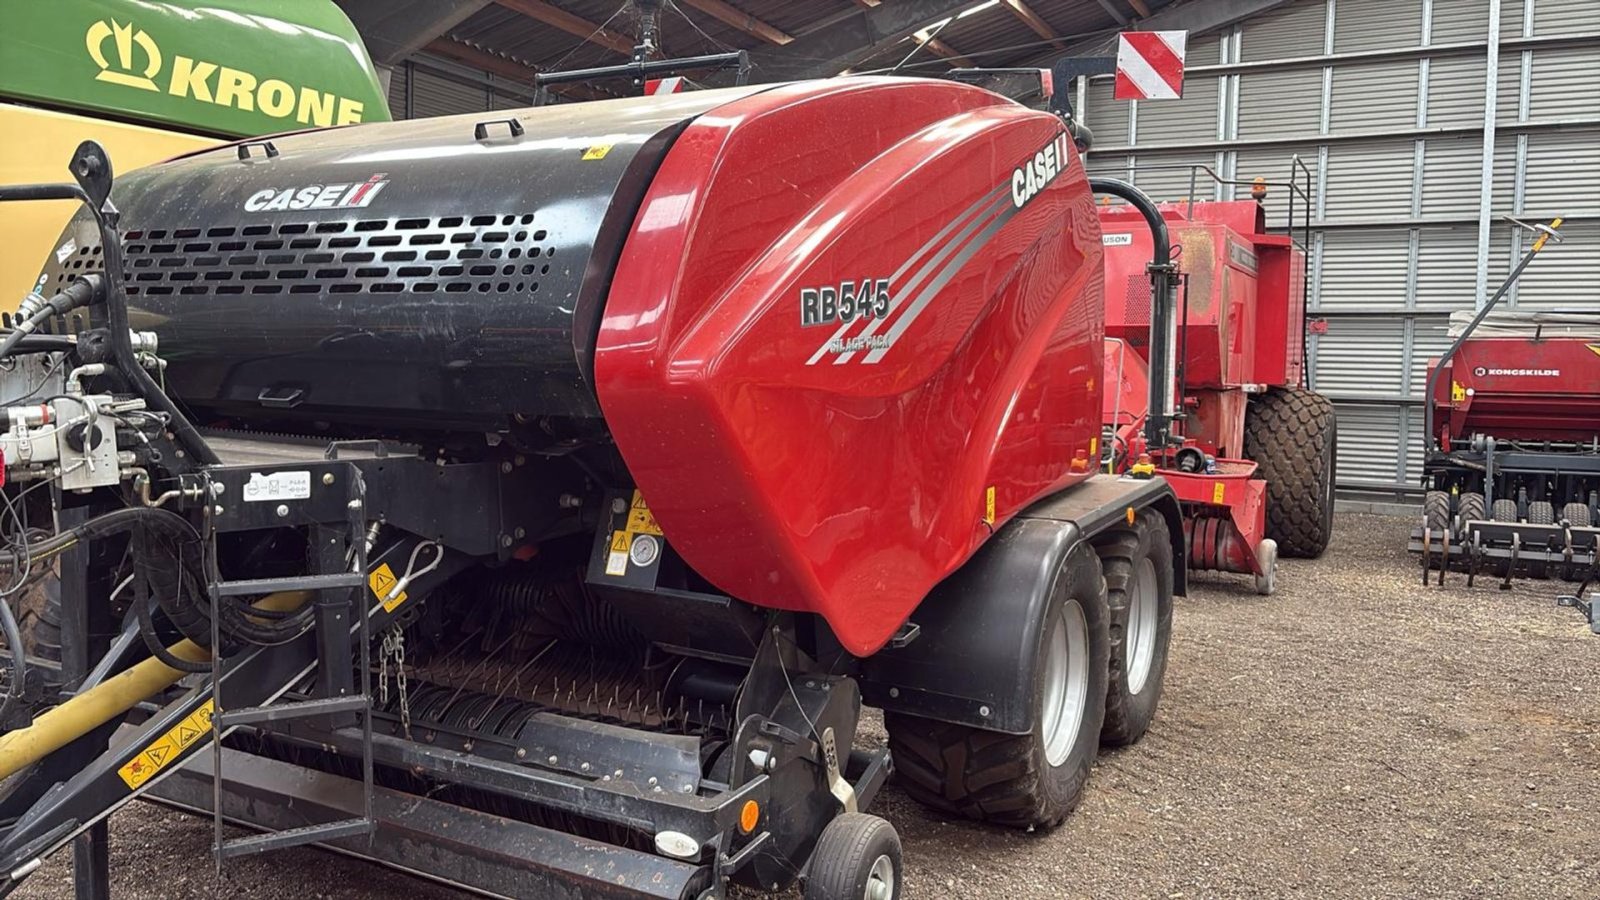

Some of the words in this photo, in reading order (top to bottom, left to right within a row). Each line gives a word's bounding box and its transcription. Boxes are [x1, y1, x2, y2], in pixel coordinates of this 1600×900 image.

[168, 55, 364, 127] KRONE
[801, 279, 889, 327] RB545
[865, 334, 890, 349] PACK
[1488, 368, 1560, 377] KONGSKILDE
